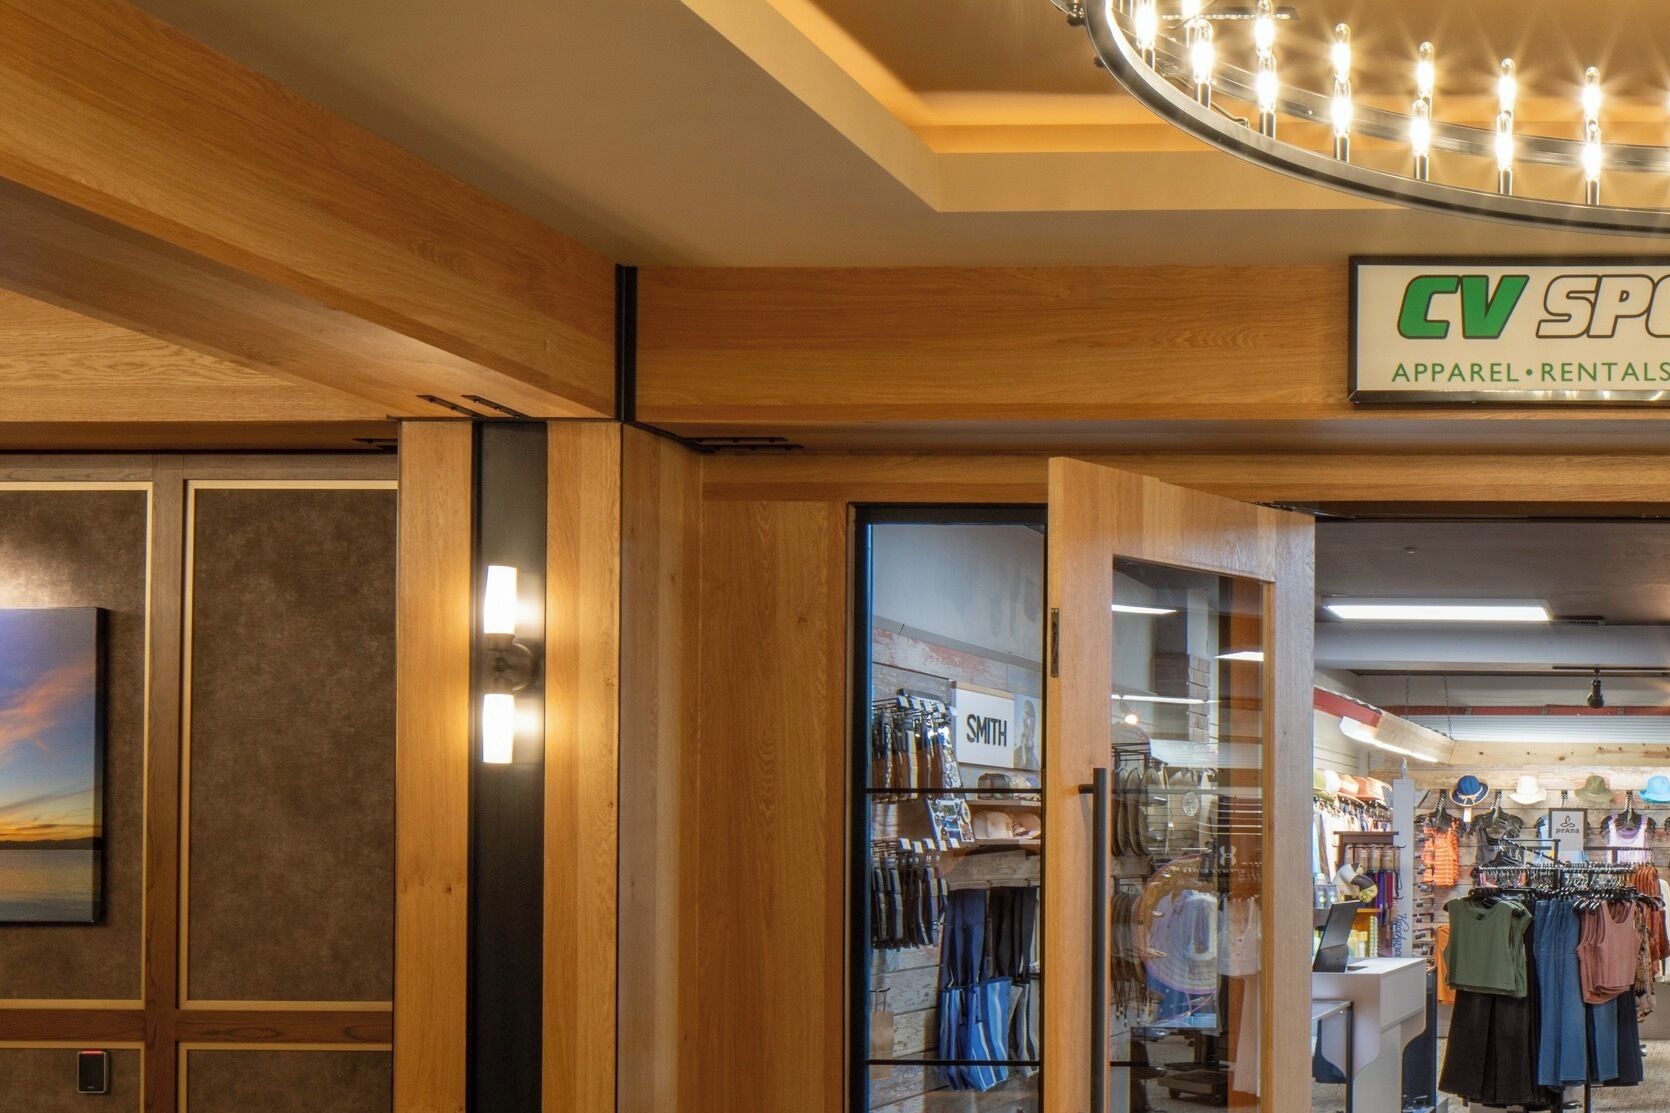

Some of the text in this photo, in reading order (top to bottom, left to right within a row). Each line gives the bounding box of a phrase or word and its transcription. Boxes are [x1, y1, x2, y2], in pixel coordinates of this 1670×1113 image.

[1397, 274, 1530, 339] CV
[1391, 362, 1519, 382] APPAREL
[966, 713, 1007, 748] SMITH
